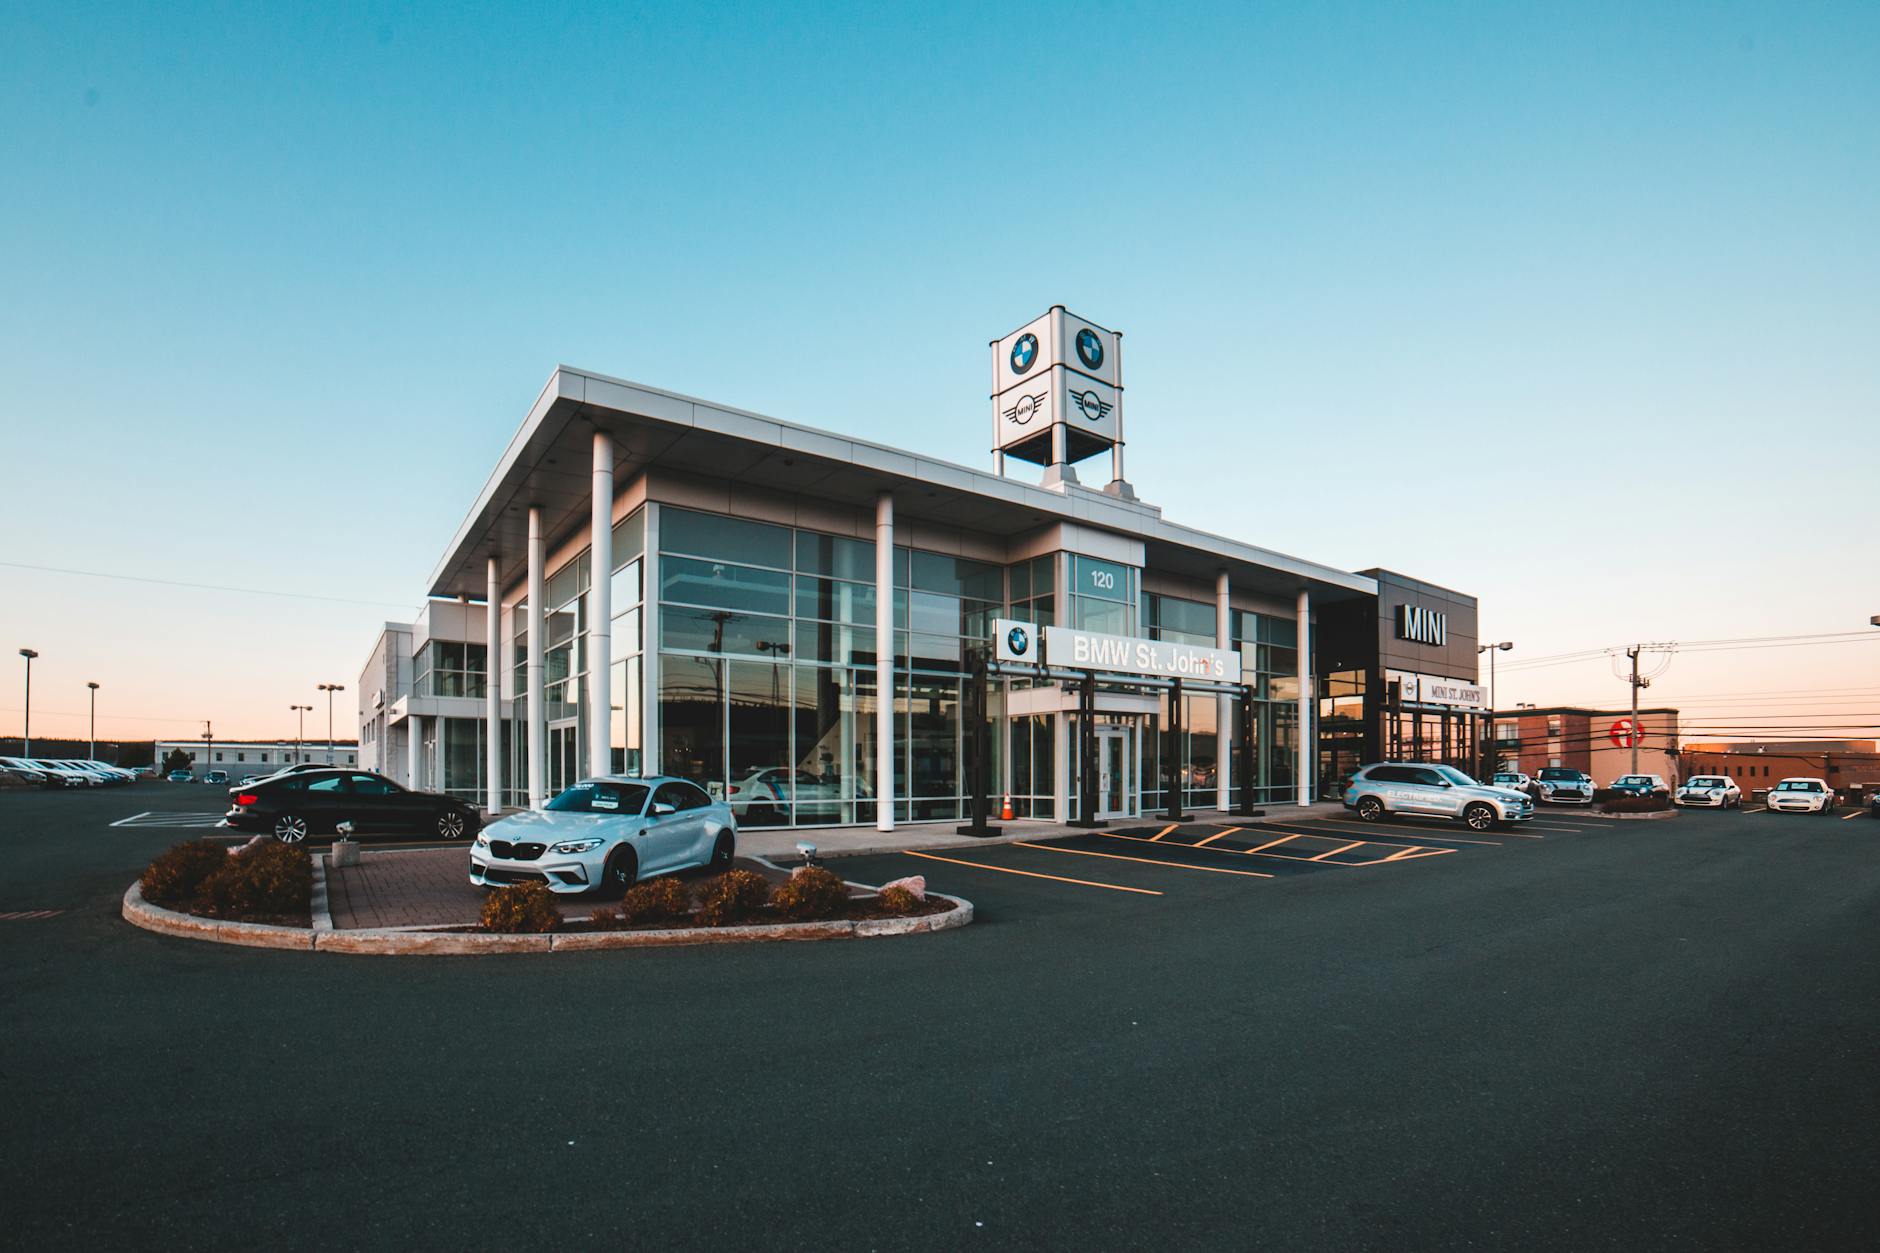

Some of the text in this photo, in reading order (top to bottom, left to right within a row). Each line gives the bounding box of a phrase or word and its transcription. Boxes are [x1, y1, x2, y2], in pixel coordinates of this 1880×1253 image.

[1017, 403, 1033, 416] MINI
[1091, 570, 1113, 589] 120
[1404, 604, 1446, 646] MINI
[1074, 635, 1224, 676] BMW St. John's
[1432, 686, 1480, 702] MINI ST. JOHN'S
